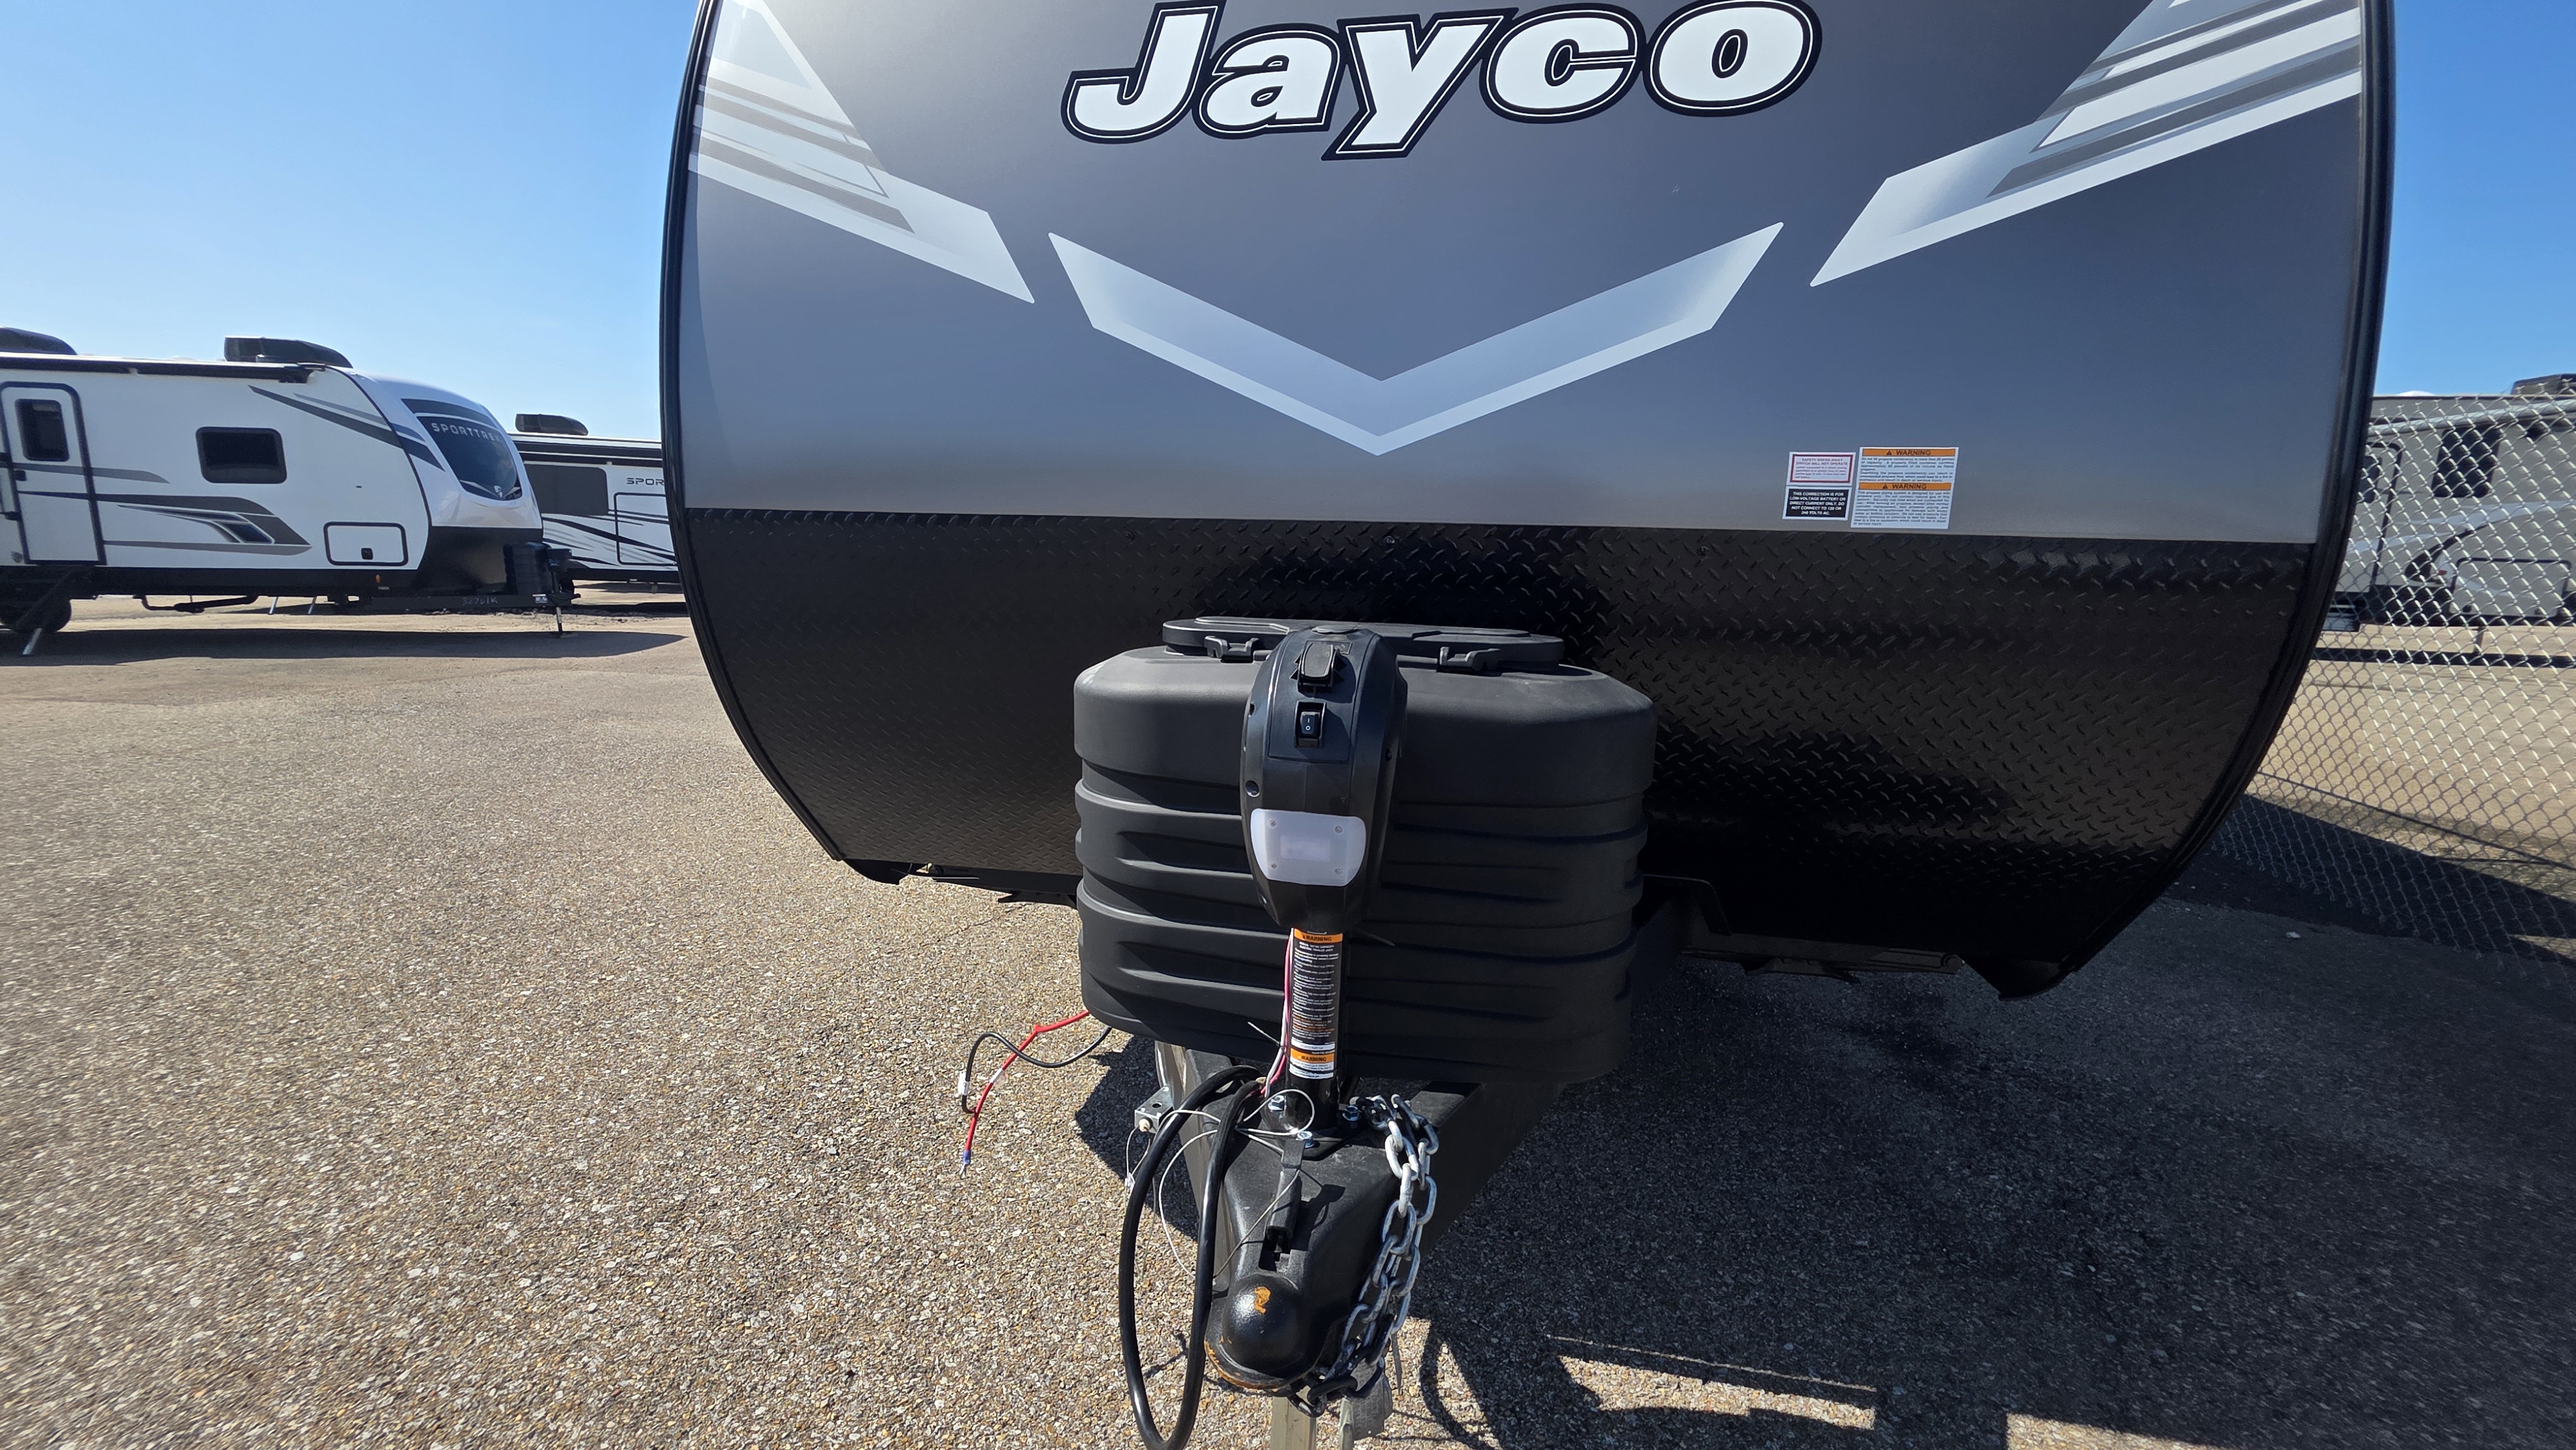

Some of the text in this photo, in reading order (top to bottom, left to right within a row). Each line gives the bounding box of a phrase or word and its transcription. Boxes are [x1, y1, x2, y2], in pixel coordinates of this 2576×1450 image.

[1061, 0, 1822, 160] Jayco
[431, 422, 502, 443] SPORTTREK
[626, 477, 665, 486] SPOR
